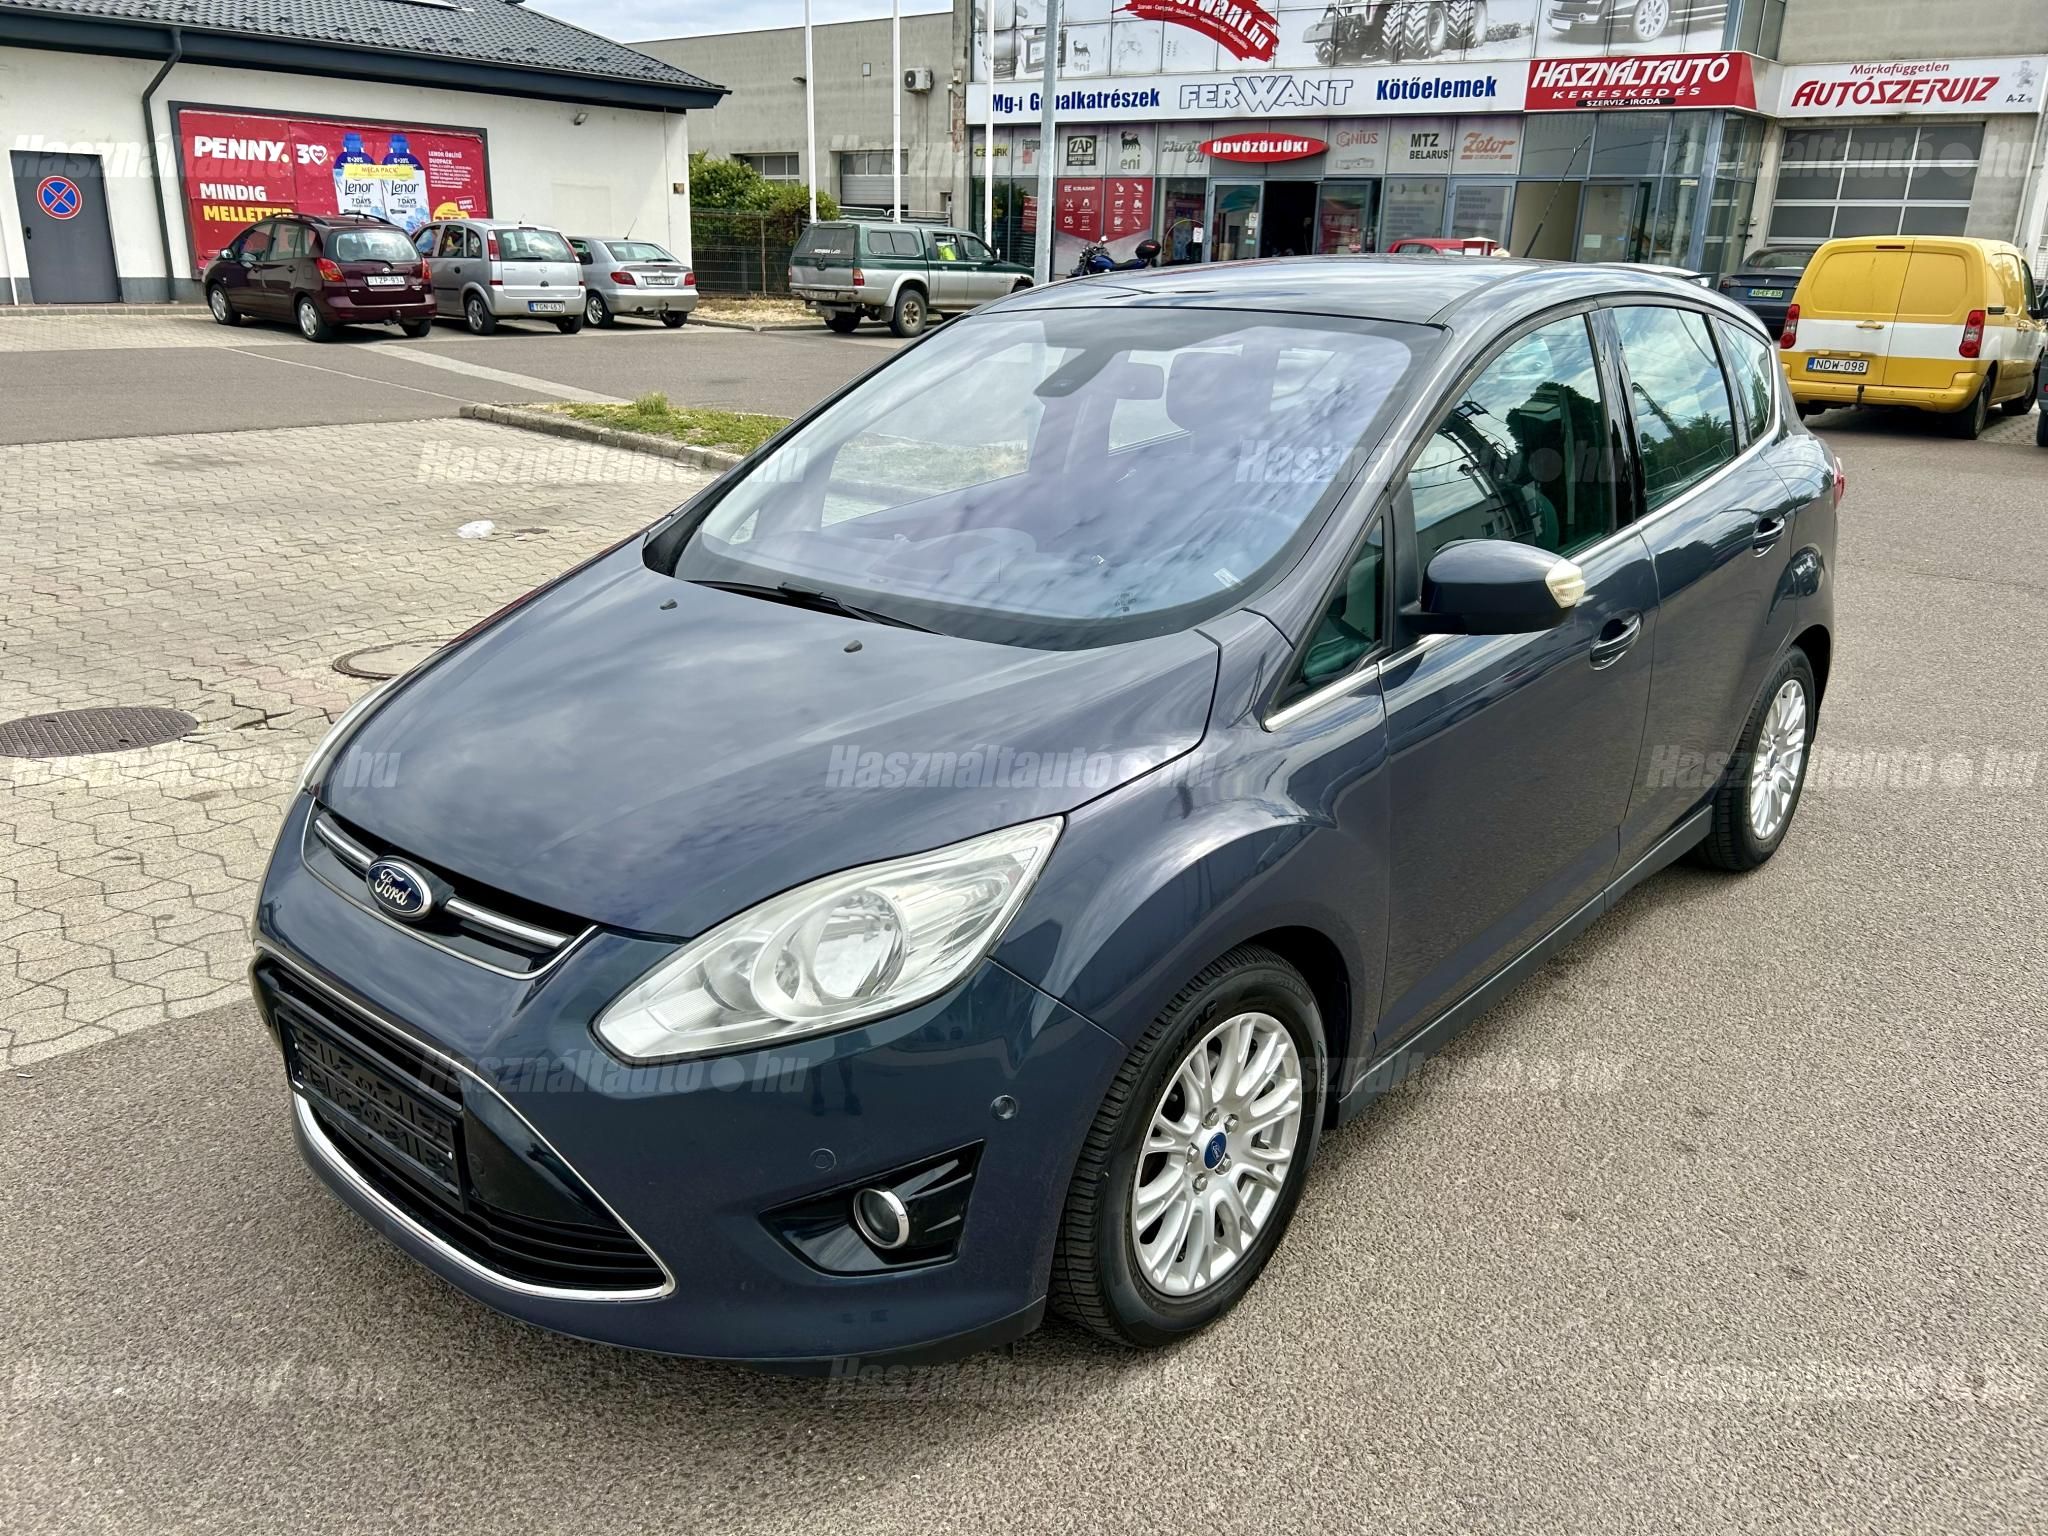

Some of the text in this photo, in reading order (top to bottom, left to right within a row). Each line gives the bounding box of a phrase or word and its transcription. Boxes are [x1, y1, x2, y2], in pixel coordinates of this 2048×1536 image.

[1531, 54, 1731, 88] HASZNÁLTAUTÓ
[1850, 62, 1950, 76] Márkafüggetlen
[1376, 76, 1497, 101] Kötőelemek
[1552, 86, 1701, 99] KERESKEDÉS
[1791, 76, 2000, 108] AUTÓSZERVIZ
[1030, 88, 1160, 111] Galkatrészek
[1070, 139, 1093, 153] ZAP
[1212, 140, 1309, 154] ÜDVÖZÖLJÜK!
[1410, 133, 1440, 148] MTZ
[1463, 131, 1516, 153] Zetor
[1119, 155, 1141, 170] eni
[1409, 150, 1449, 160] BELARUS
[200, 182, 267, 201] MINDIG
[345, 180, 374, 195] Lenor
[391, 180, 420, 196] Lenor
[1815, 359, 1865, 372] NDW-098
[374, 868, 412, 906] Ford
